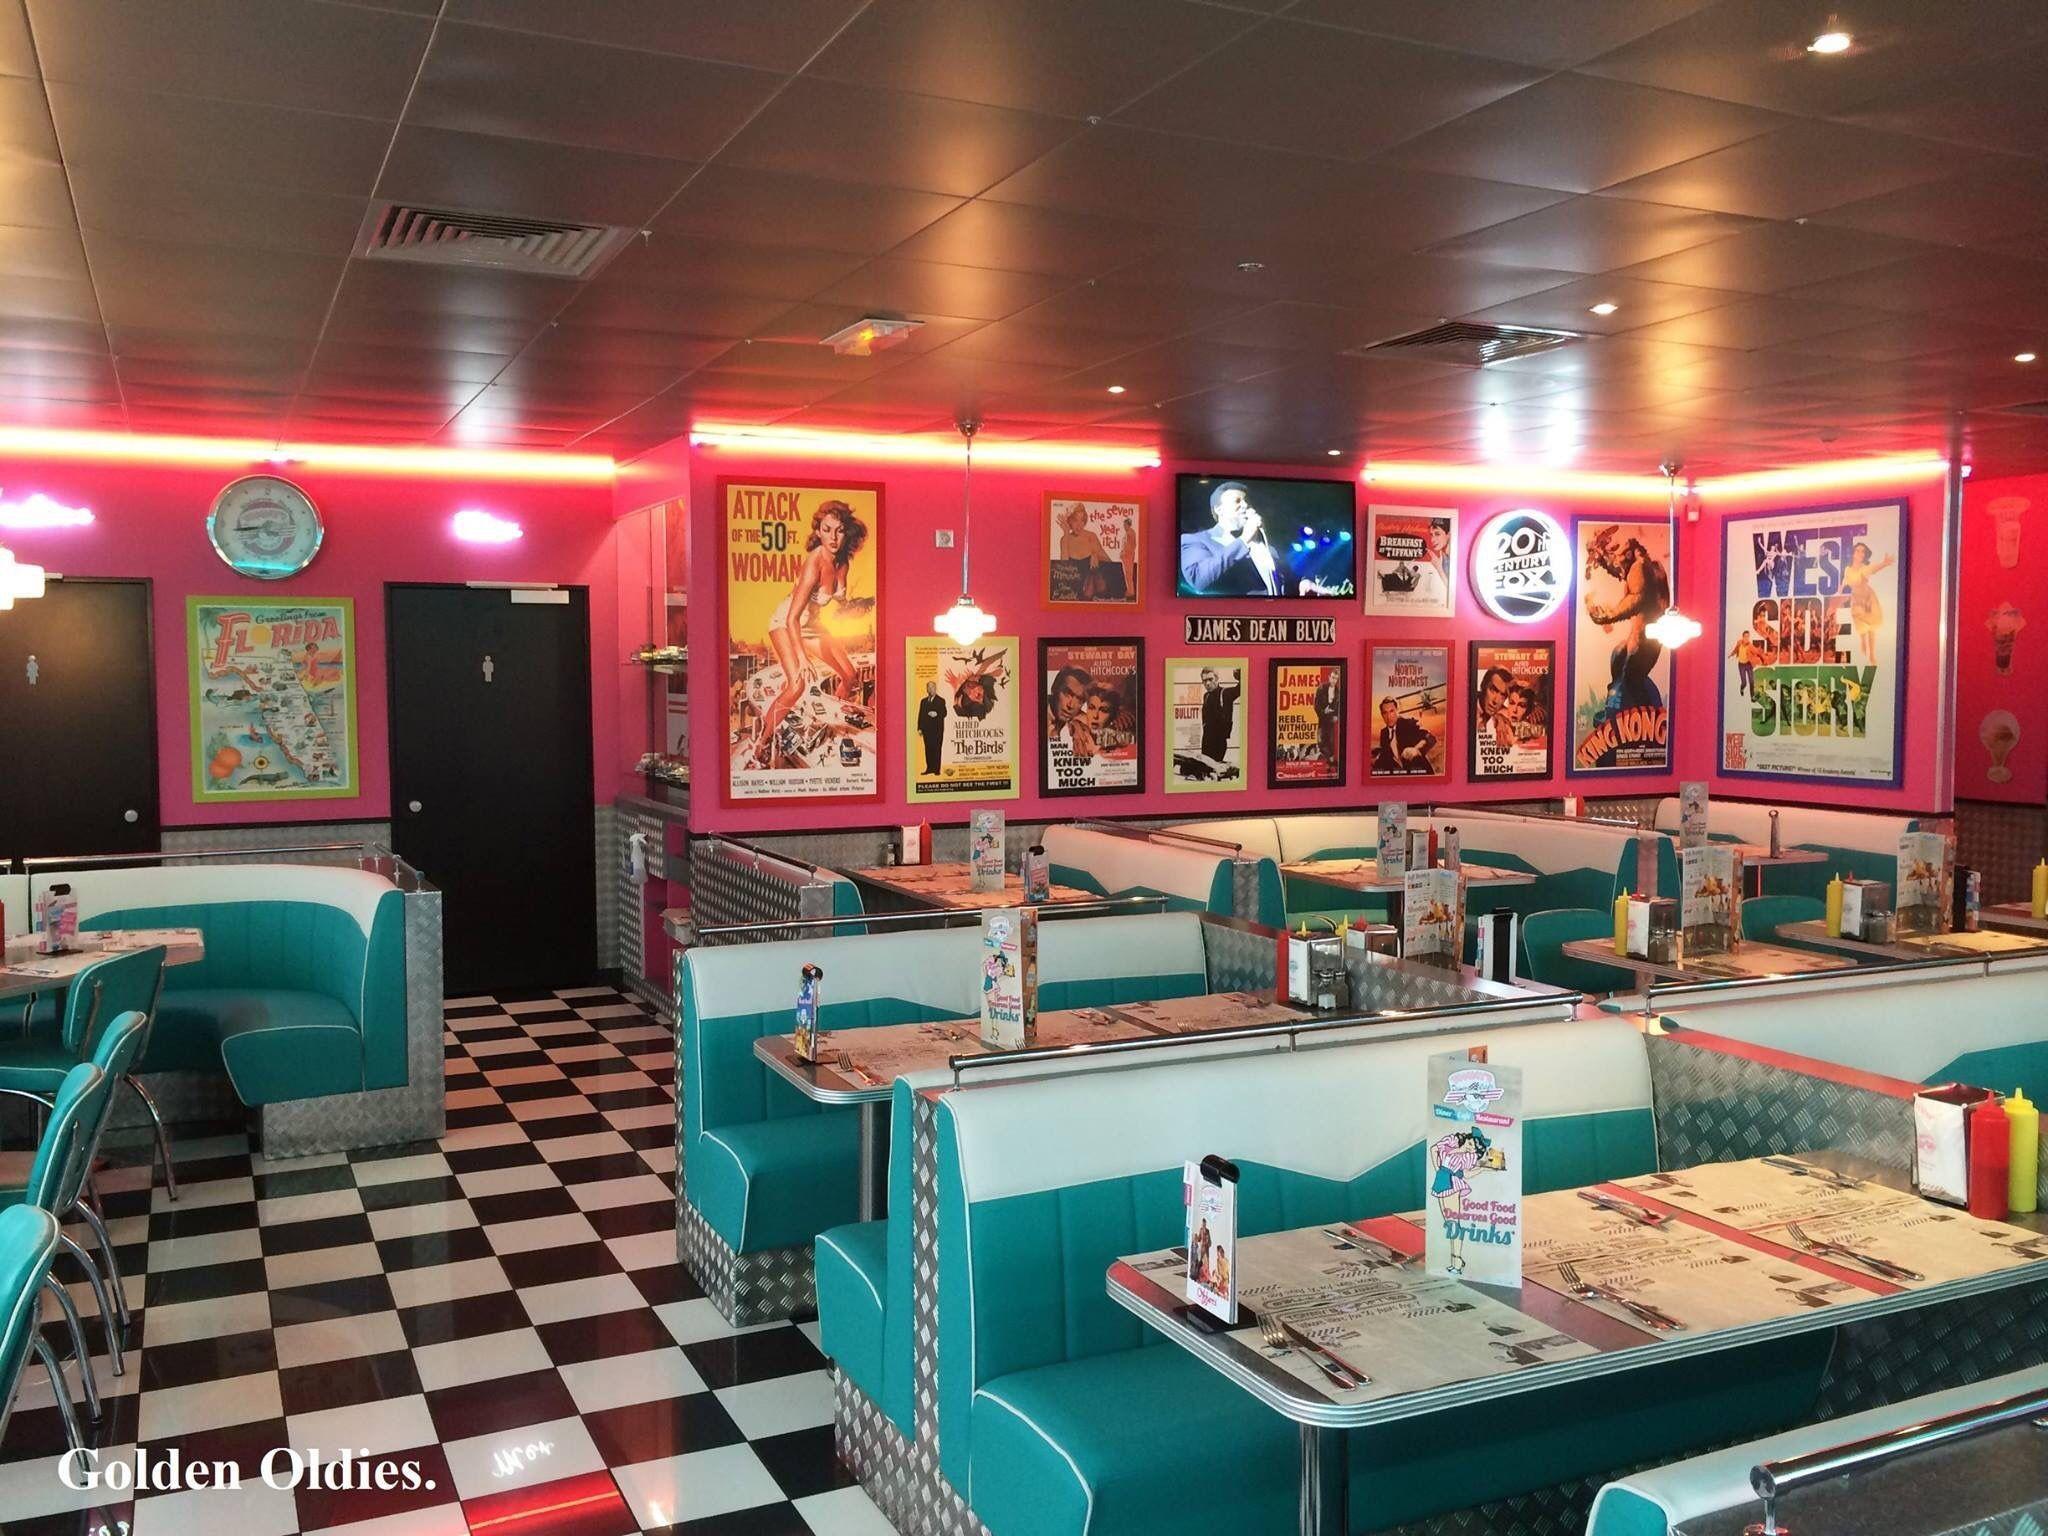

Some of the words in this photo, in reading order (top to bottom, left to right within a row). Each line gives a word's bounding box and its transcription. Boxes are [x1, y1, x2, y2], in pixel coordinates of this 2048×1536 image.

[733, 490, 801, 521] ATTACK
[1090, 509, 1105, 522] the
[1100, 524, 1120, 535] year
[732, 529, 744, 543] OF
[745, 529, 760, 544] THE
[761, 521, 786, 552] 50
[1102, 536, 1120, 549] itch
[1380, 536, 1423, 548] BREAKFAST
[1385, 547, 1423, 558] TIFFANY'S
[1753, 524, 1867, 598] WEST
[731, 553, 801, 583] WOMAN
[1193, 619, 1241, 642] JAMES
[1250, 620, 1287, 642] DEAN
[1296, 620, 1330, 642] BLVD
[1751, 596, 1851, 666] SIDE
[1067, 651, 1113, 660] STEWART
[1117, 651, 1136, 659] DAY
[1090, 665, 1137, 676] HITCHCOCK'S
[1394, 664, 1417, 676] NORTH
[1279, 668, 1321, 688] JAMES
[1388, 676, 1428, 688] NORTHWEST
[1279, 690, 1314, 711] DEAN
[1751, 665, 1878, 738] STORY
[1174, 707, 1200, 720] BULLITT
[1278, 715, 1307, 723] REBEL
[1278, 723, 1319, 732] WITHOUT
[1279, 732, 1285, 740] A
[1287, 731, 1316, 740] CAUSE
[1576, 719, 1619, 769] KING
[1616, 706, 1667, 745] KONG
[1480, 747, 1511, 756] KNEW
[1053, 757, 1092, 767] KNEW
[1482, 756, 1504, 765] TOO
[1056, 768, 1084, 777] TOO
[1484, 765, 1513, 774] MUCH
[1058, 777, 1096, 788] MUCH
[1462, 1198, 1489, 1211] Good
[1490, 1200, 1516, 1213] Food
[1443, 1208, 1488, 1222] Deserves
[1489, 1212, 1517, 1225] Good
